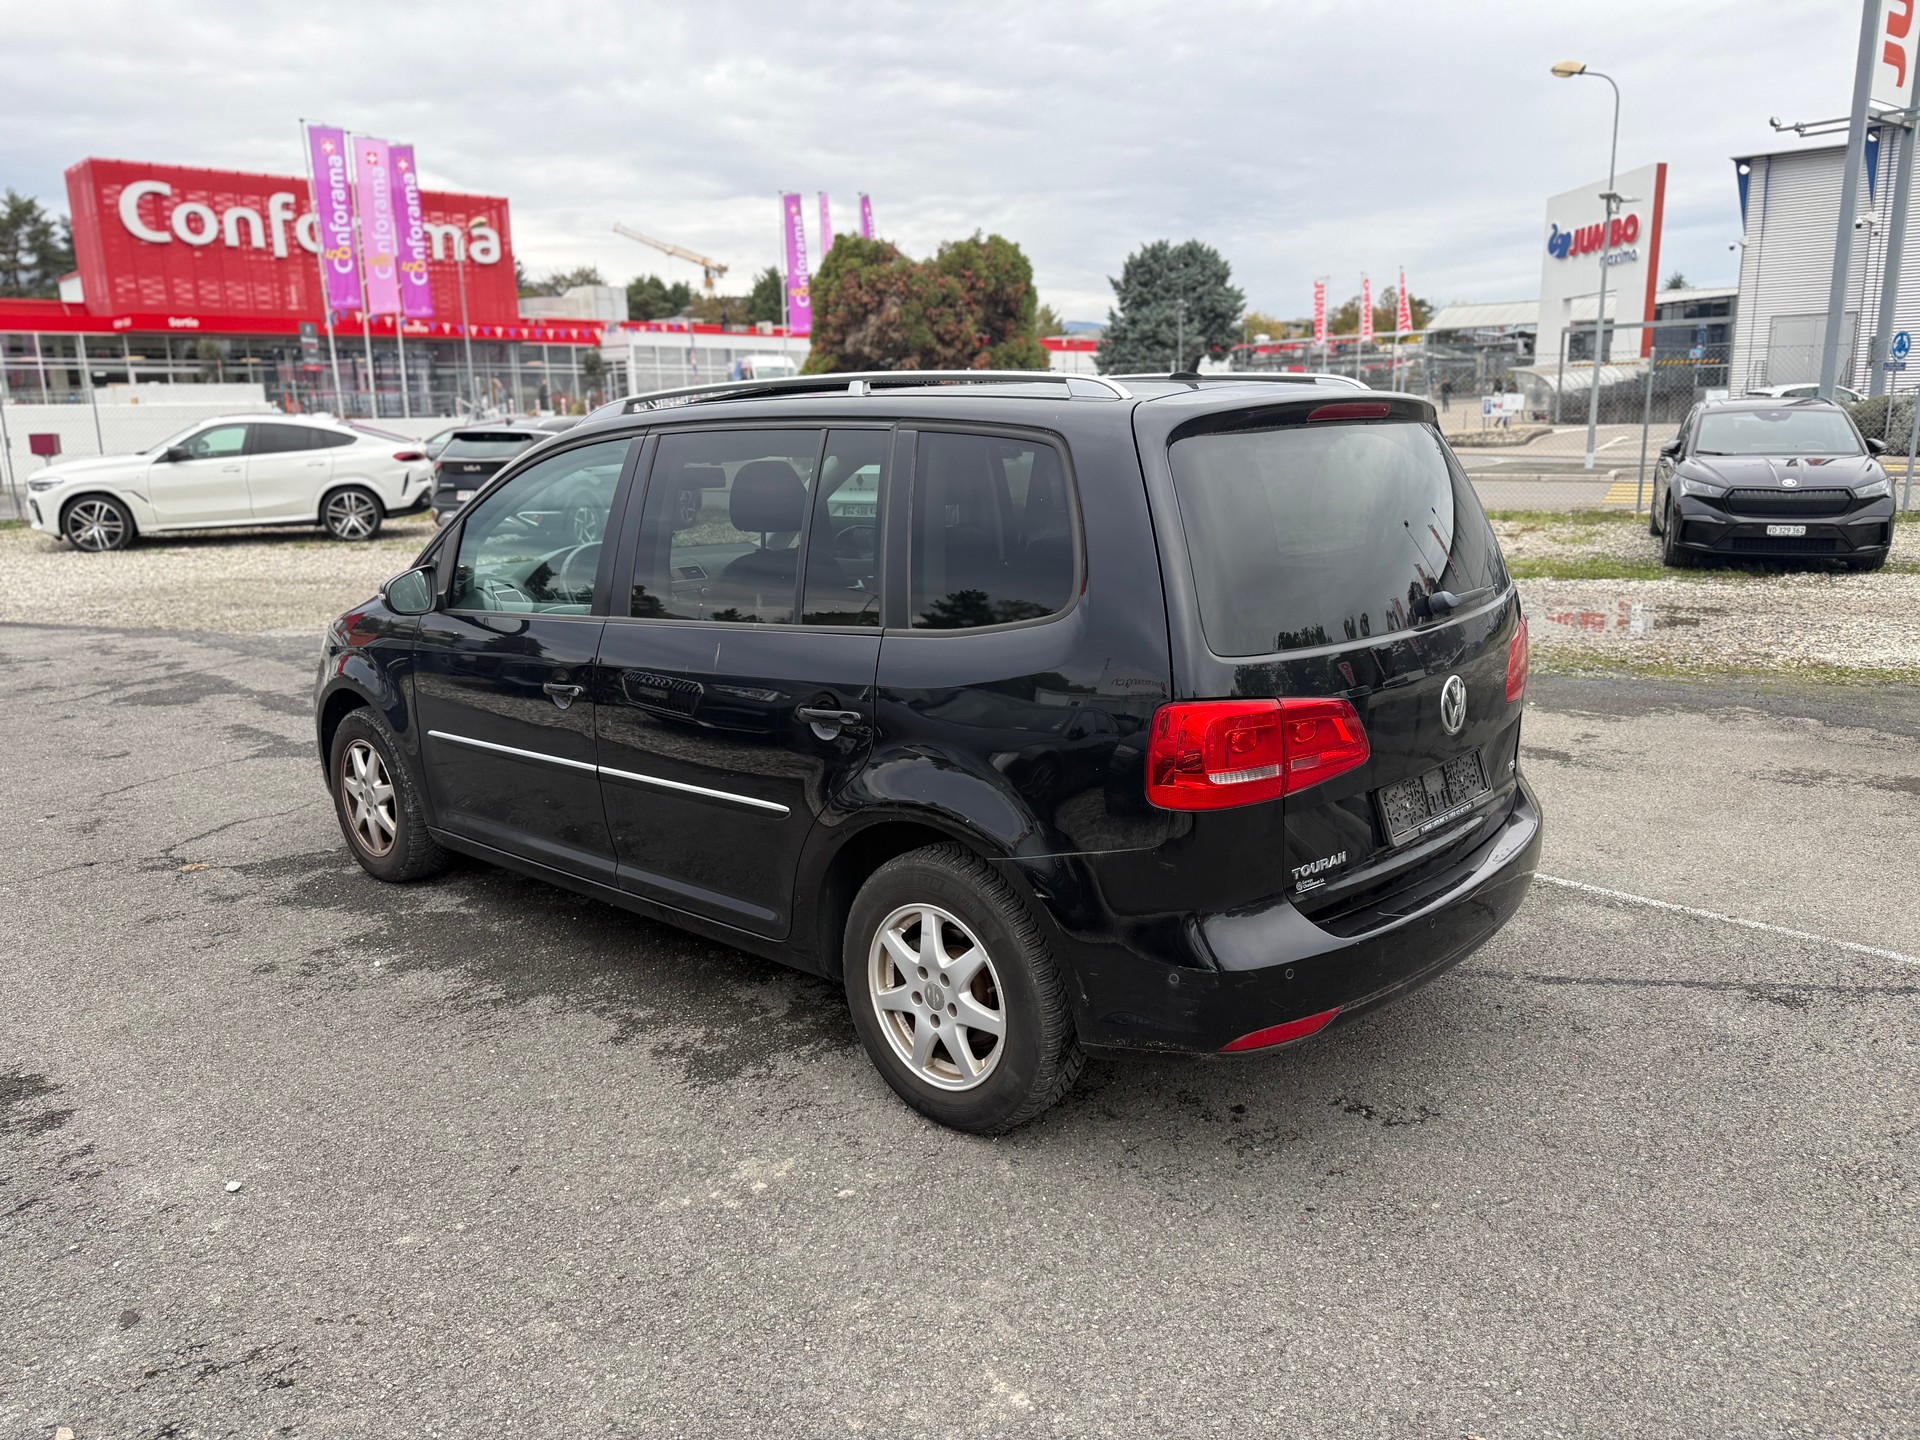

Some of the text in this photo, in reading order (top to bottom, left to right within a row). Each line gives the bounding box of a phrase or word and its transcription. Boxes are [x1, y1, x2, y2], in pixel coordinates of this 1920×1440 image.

[118, 179, 502, 266] Confoma
[1569, 213, 1639, 257] JUMBO
[1291, 850, 1346, 880] TOURAN
